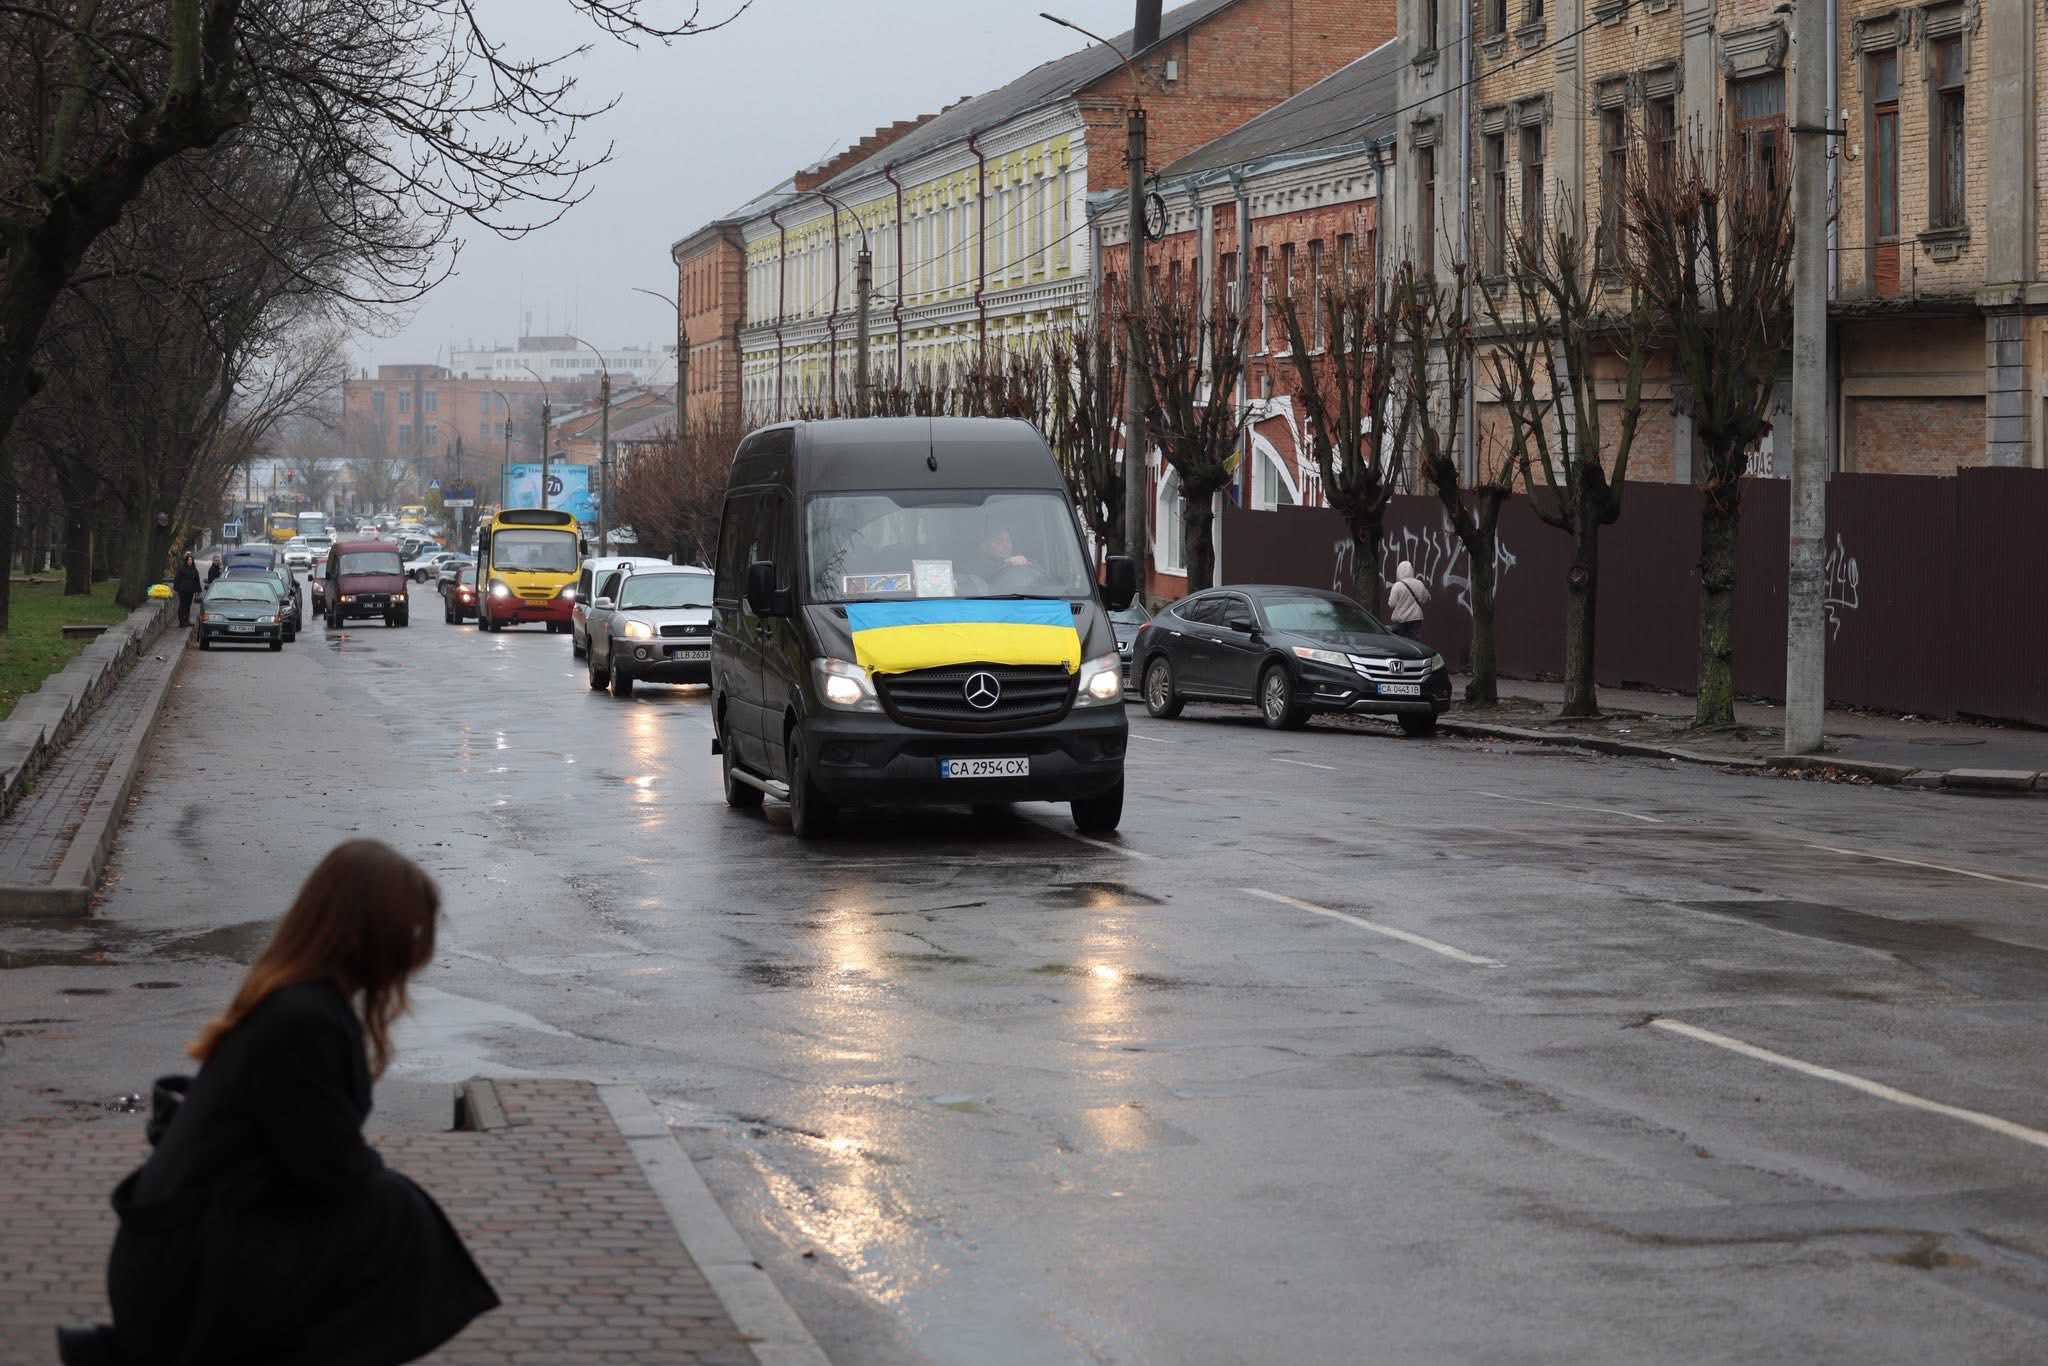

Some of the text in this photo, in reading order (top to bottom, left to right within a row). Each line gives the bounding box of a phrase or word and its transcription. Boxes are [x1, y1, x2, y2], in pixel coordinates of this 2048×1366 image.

[692, 651, 711, 659] 2633
[950, 762, 969, 775] CA
[972, 761, 1003, 775] 2954
[1006, 760, 1024, 774] CX
